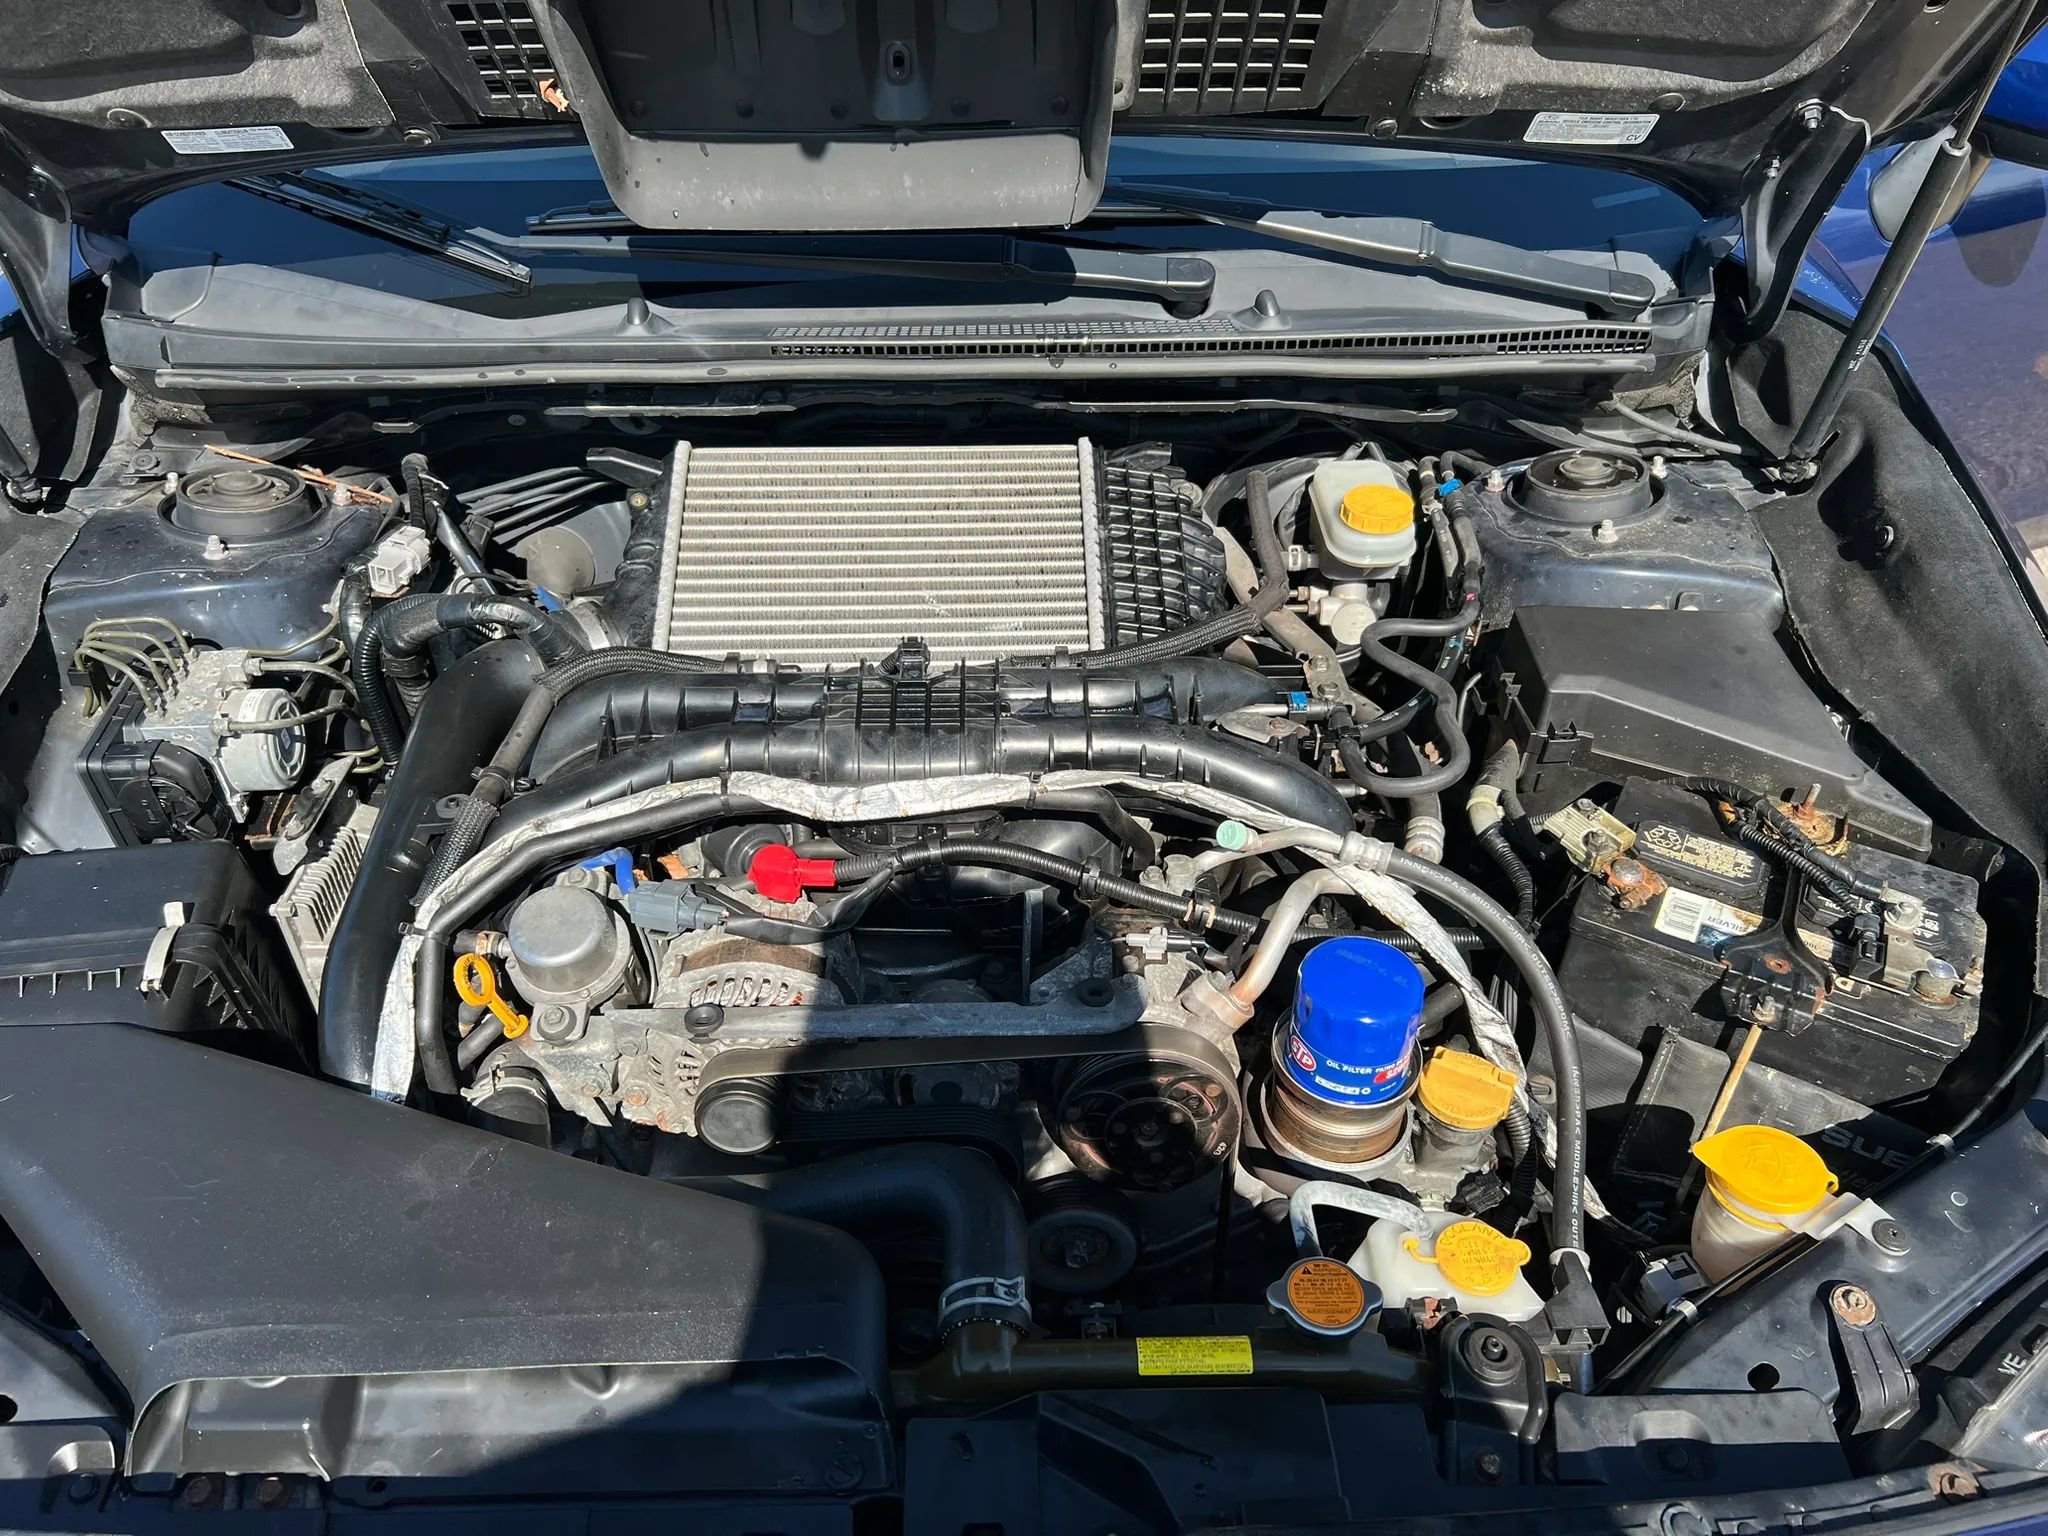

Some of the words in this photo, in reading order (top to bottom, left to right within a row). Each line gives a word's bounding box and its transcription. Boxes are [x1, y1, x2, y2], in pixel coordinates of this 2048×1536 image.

[1291, 1039, 1314, 1067] STP
[1326, 1060, 1341, 1071] OIL
[1342, 1064, 1373, 1075] FILTER
